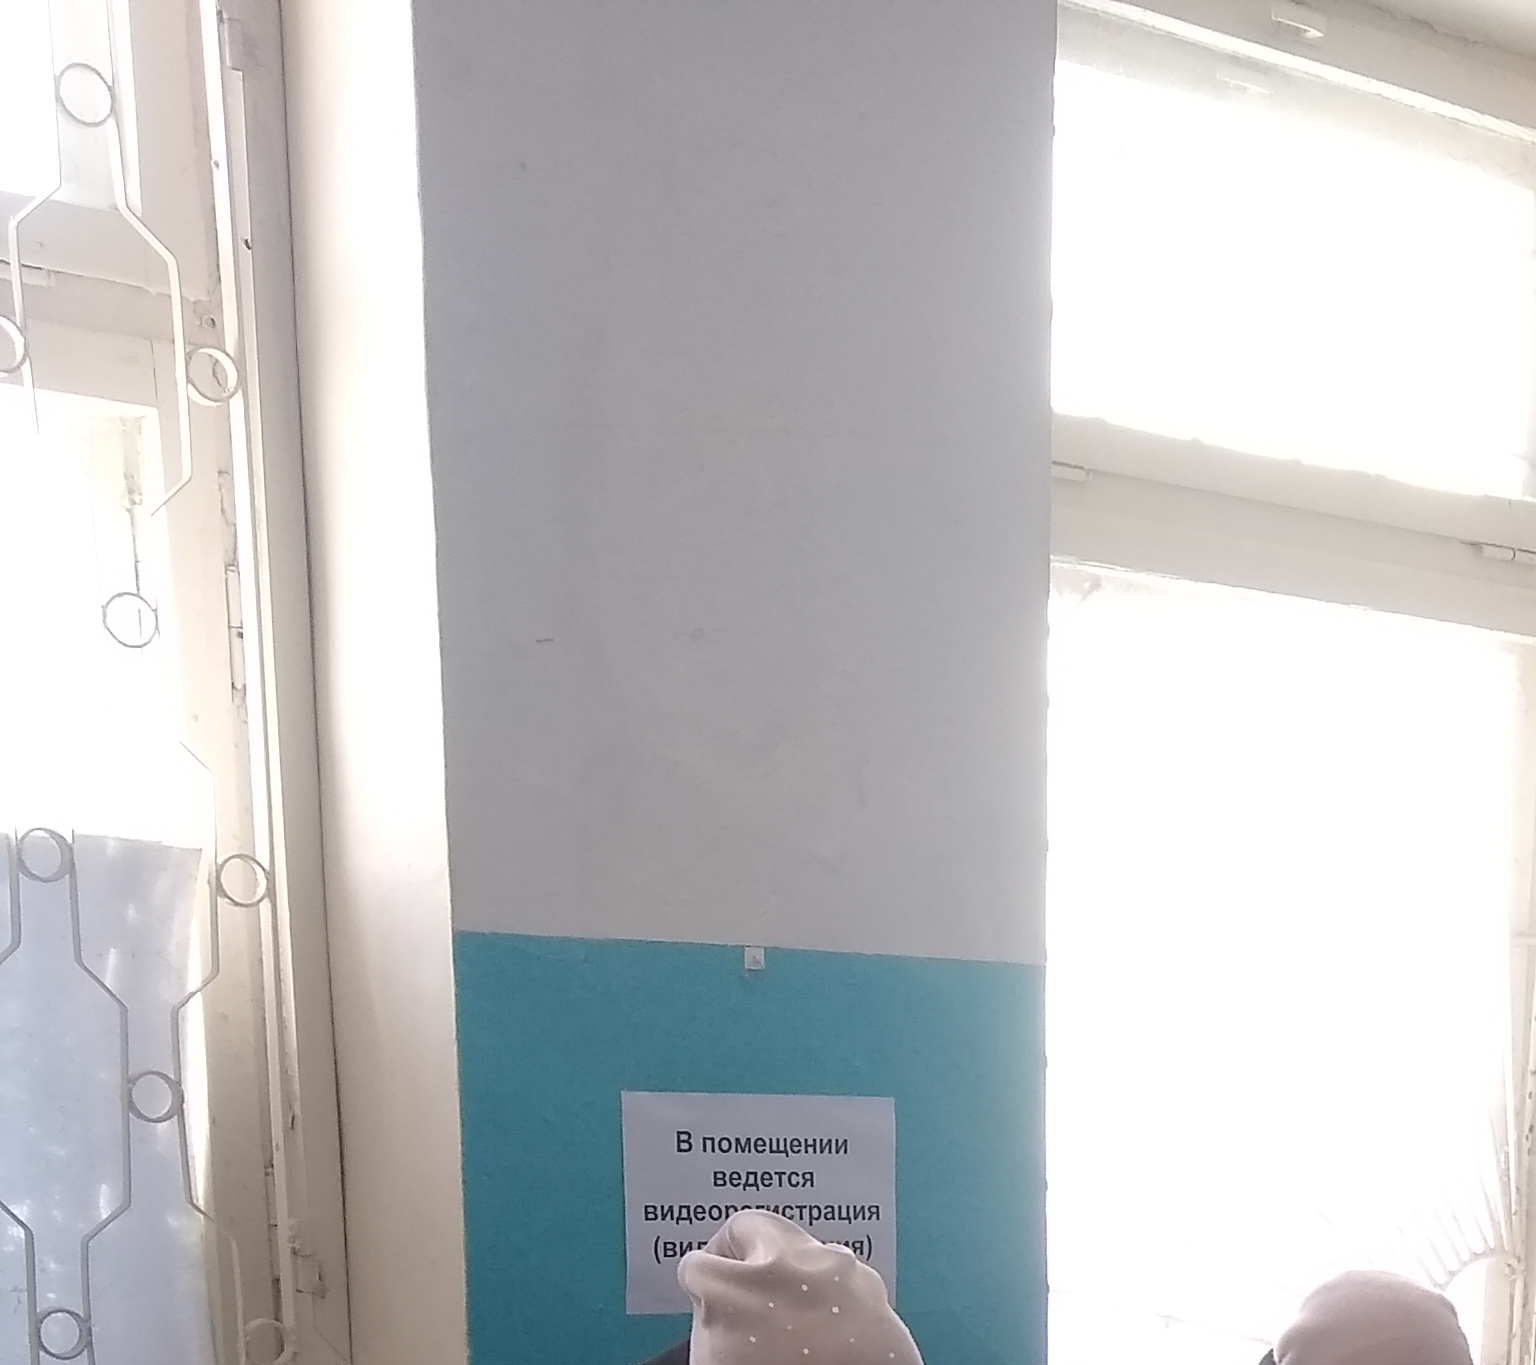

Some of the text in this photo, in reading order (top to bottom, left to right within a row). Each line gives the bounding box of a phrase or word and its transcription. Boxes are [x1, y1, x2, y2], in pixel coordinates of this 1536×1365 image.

[675, 1130, 849, 1158] В помещении
[712, 1170, 815, 1191] ведется
[643, 1203, 880, 1226] видеористрация
